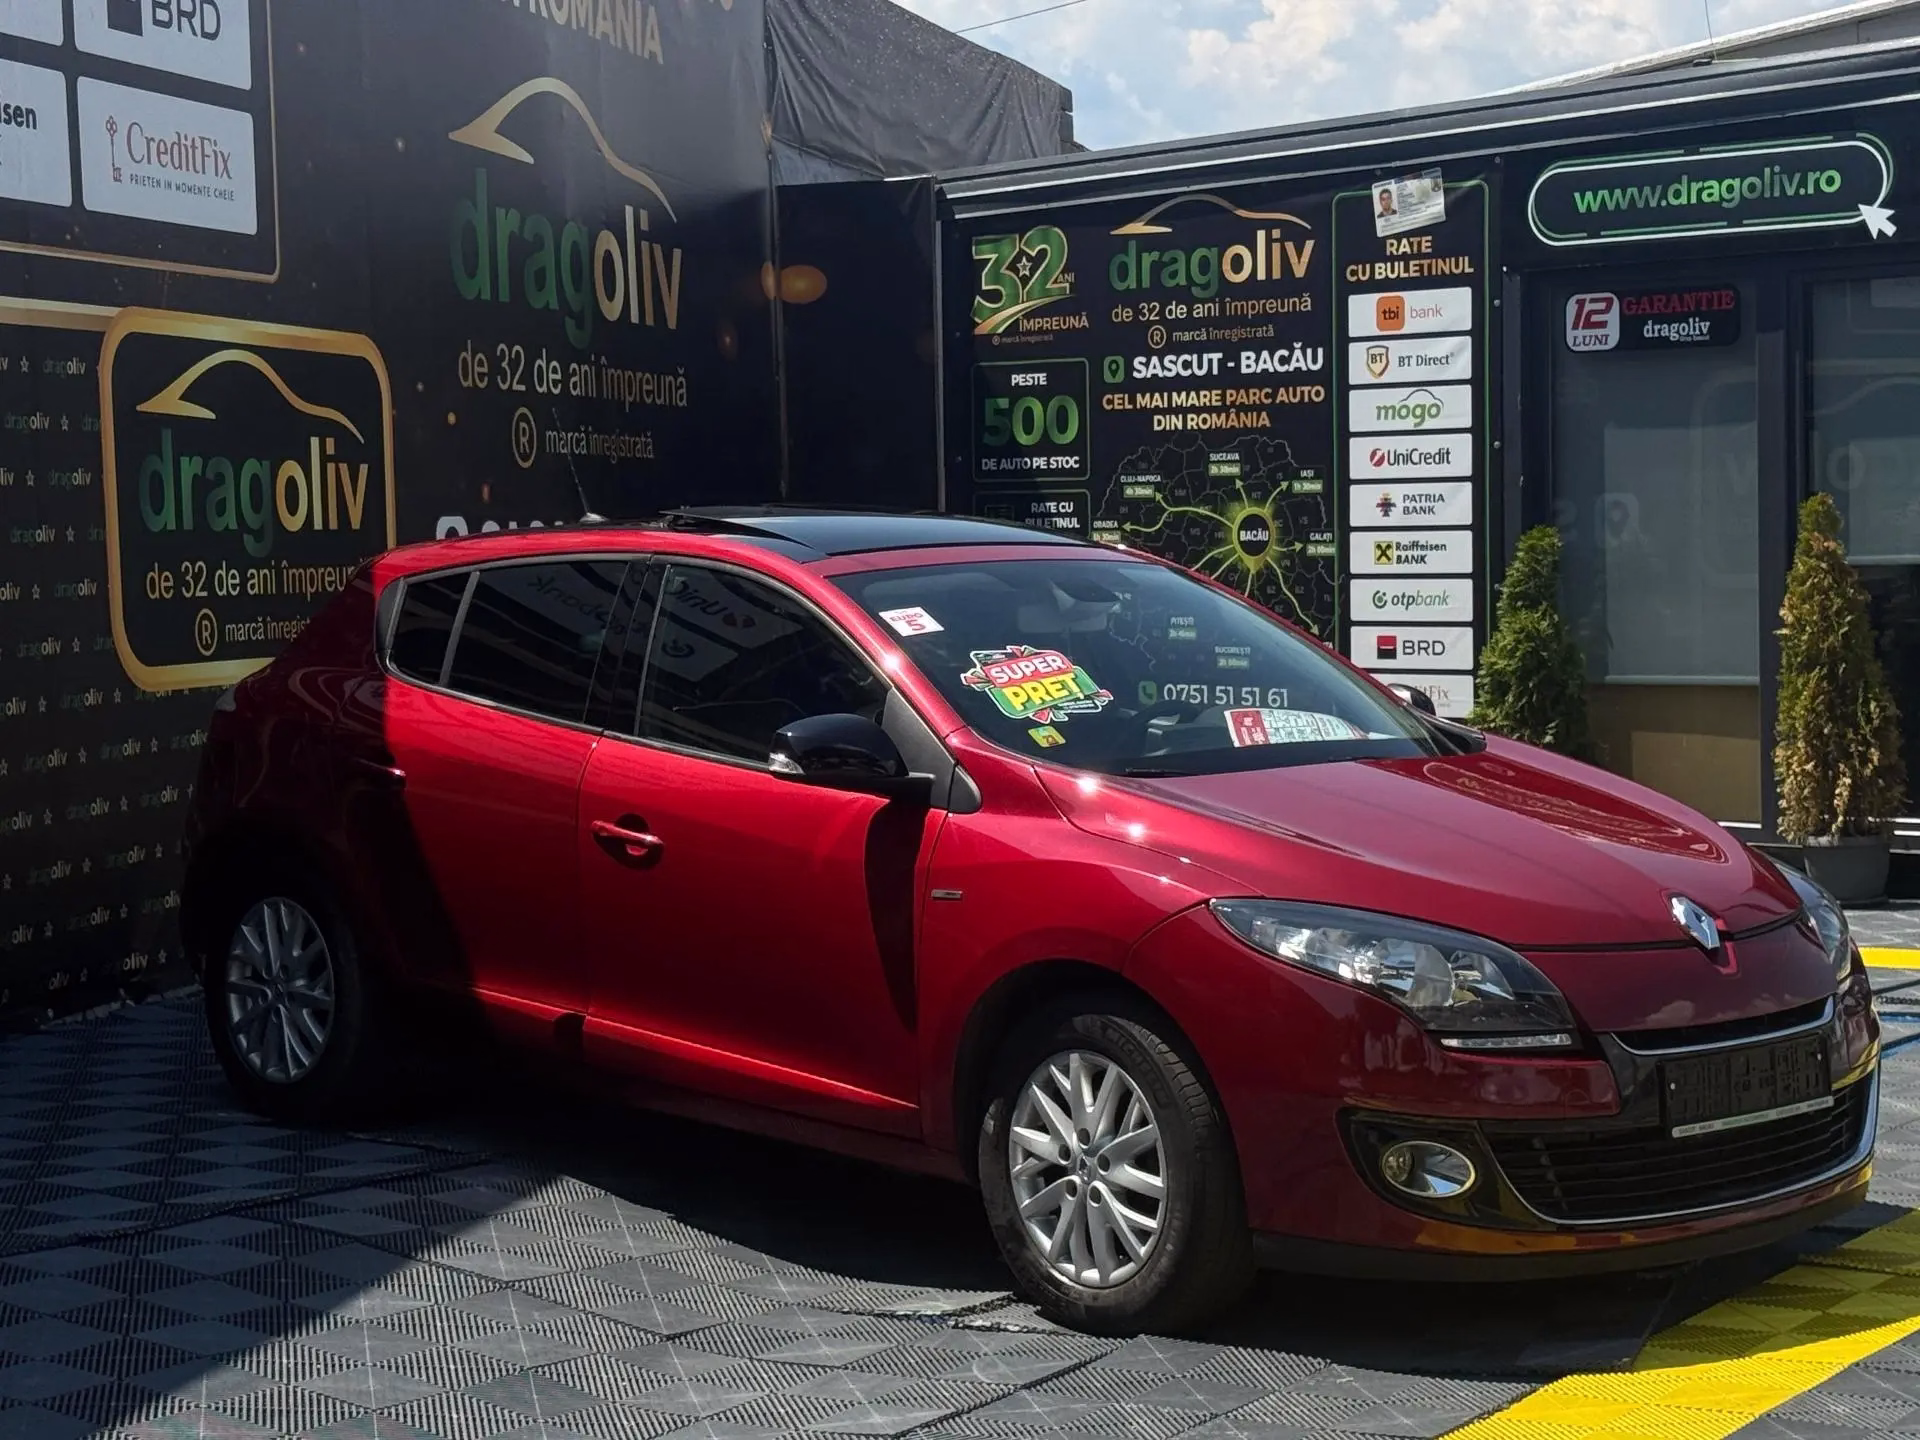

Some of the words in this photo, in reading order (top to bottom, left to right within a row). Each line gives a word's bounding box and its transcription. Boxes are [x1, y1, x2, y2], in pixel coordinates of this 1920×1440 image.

[152, 0, 221, 41] BRD
[126, 121, 233, 180] CreditFix
[130, 173, 161, 188] PRIETEN
[163, 178, 173, 190] IN
[174, 181, 211, 198] MOMENTE
[213, 187, 235, 201] CHEIE
[1573, 165, 1842, 214] www.dragoliv.ro
[1386, 236, 1433, 255] RATE
[450, 168, 682, 349] dragoliv
[1109, 228, 1315, 298] dragoliv
[1346, 265, 1370, 282] CU
[1375, 256, 1474, 280] BULETINUL
[970, 225, 1069, 324] 32
[1057, 272, 1075, 283] ANI
[1111, 304, 1133, 322] de
[1138, 302, 1160, 321] 32
[1165, 301, 1187, 319] de
[1192, 298, 1219, 318] ani
[1226, 293, 1312, 319] împreună
[1381, 306, 1400, 321] tbi
[1410, 303, 1443, 319] bank
[1571, 297, 1614, 330] 12
[1623, 290, 1735, 315] GARANTIE
[1019, 312, 1089, 332] ÎMPREUNĂ
[1172, 328, 1208, 343] marcă
[1209, 324, 1275, 343] înregistrată
[1643, 317, 1711, 341] dragoliv
[1572, 334, 1610, 347] LUNI
[1132, 352, 1223, 379] SASCUT
[1240, 341, 1324, 375] BACĂU
[1371, 354, 1384, 364] BT
[1398, 356, 1414, 367] BT
[1416, 353, 1450, 367] Direct
[459, 340, 488, 388] de
[497, 344, 526, 391] 32
[534, 348, 562, 395] de
[569, 354, 596, 397] ani
[601, 356, 688, 412] împreună
[1011, 373, 1047, 387] PESTE
[1102, 394, 1134, 411] CEL
[1136, 392, 1168, 408] MAI
[1171, 390, 1222, 408] MARE
[1226, 388, 1272, 405] PARC
[1276, 385, 1325, 403] AUTO
[981, 395, 1079, 447] 500
[1153, 414, 1183, 431] DIN
[1187, 408, 1271, 430] ROMÂNIA
[1376, 402, 1442, 428] mogo
[546, 425, 587, 455] marcă
[589, 425, 654, 464] înregistrată
[982, 458, 998, 471] DE
[999, 457, 1031, 470] AUTO
[1033, 457, 1048, 470] PE
[1049, 455, 1080, 469] STOC
[1210, 453, 1239, 461] SUCEAVA
[1387, 448, 1451, 466] UniCredit
[138, 428, 369, 557] dragoliv
[1403, 493, 1445, 504] PATRIA
[1031, 502, 1057, 513] RATE
[1059, 501, 1074, 513] CU
[1403, 505, 1436, 516] BANK
[1240, 528, 1269, 541] BACĂU
[1395, 541, 1447, 552] Raiffeisen
[1395, 554, 1427, 565] BANK
[146, 563, 174, 599] de
[180, 561, 208, 597] 32
[214, 560, 240, 596] de
[247, 559, 276, 596] ani
[281, 560, 356, 602] împreu
[1391, 590, 1449, 610] otpbank
[225, 616, 265, 641] marcă
[905, 620, 926, 631] 5
[1402, 640, 1446, 656] BRD
[990, 655, 1067, 684] SUPER
[1002, 672, 1085, 712] PREȚ
[1164, 683, 1208, 704] 0751
[1215, 686, 1234, 705] 51
[1241, 687, 1260, 706] 51
[1268, 688, 1288, 707] 61
